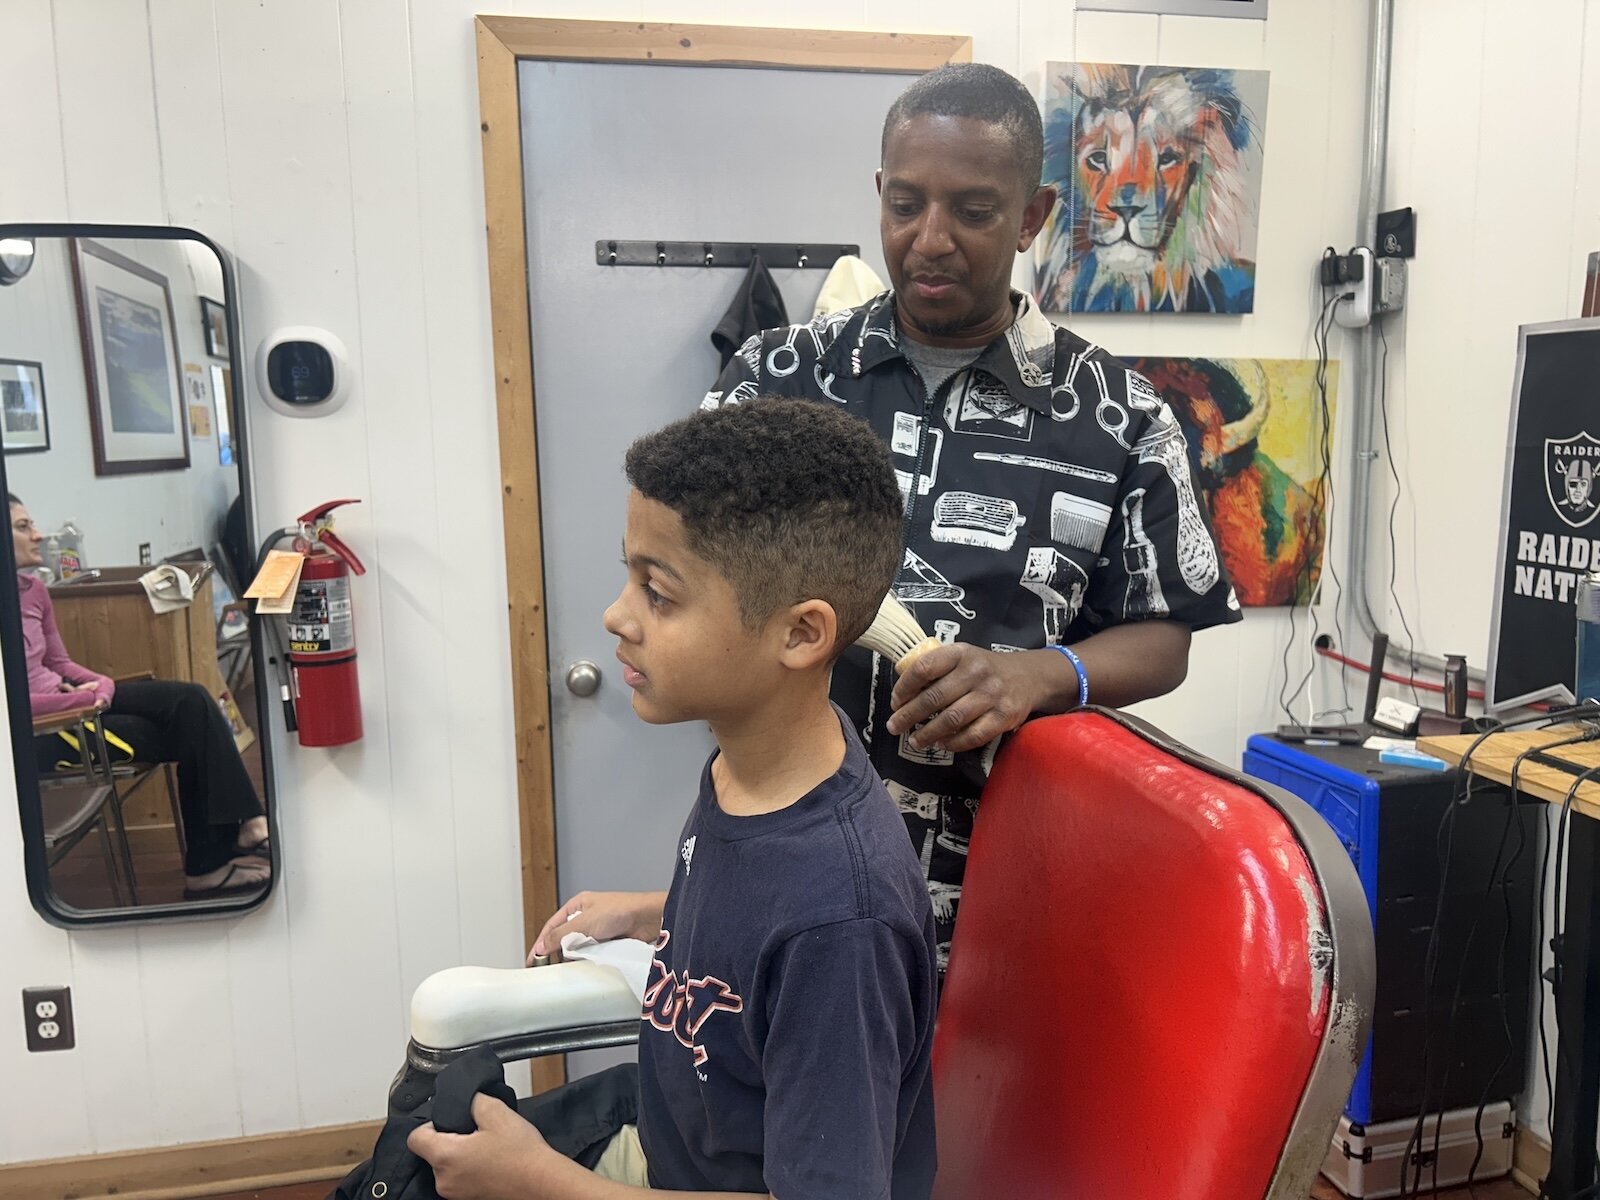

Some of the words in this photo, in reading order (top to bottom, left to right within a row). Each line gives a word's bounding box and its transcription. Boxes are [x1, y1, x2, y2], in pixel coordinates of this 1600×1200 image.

[1554, 445, 1600, 457] RAIDER
[1517, 530, 1600, 573] RAIDE
[1514, 565, 1584, 605] NAT
